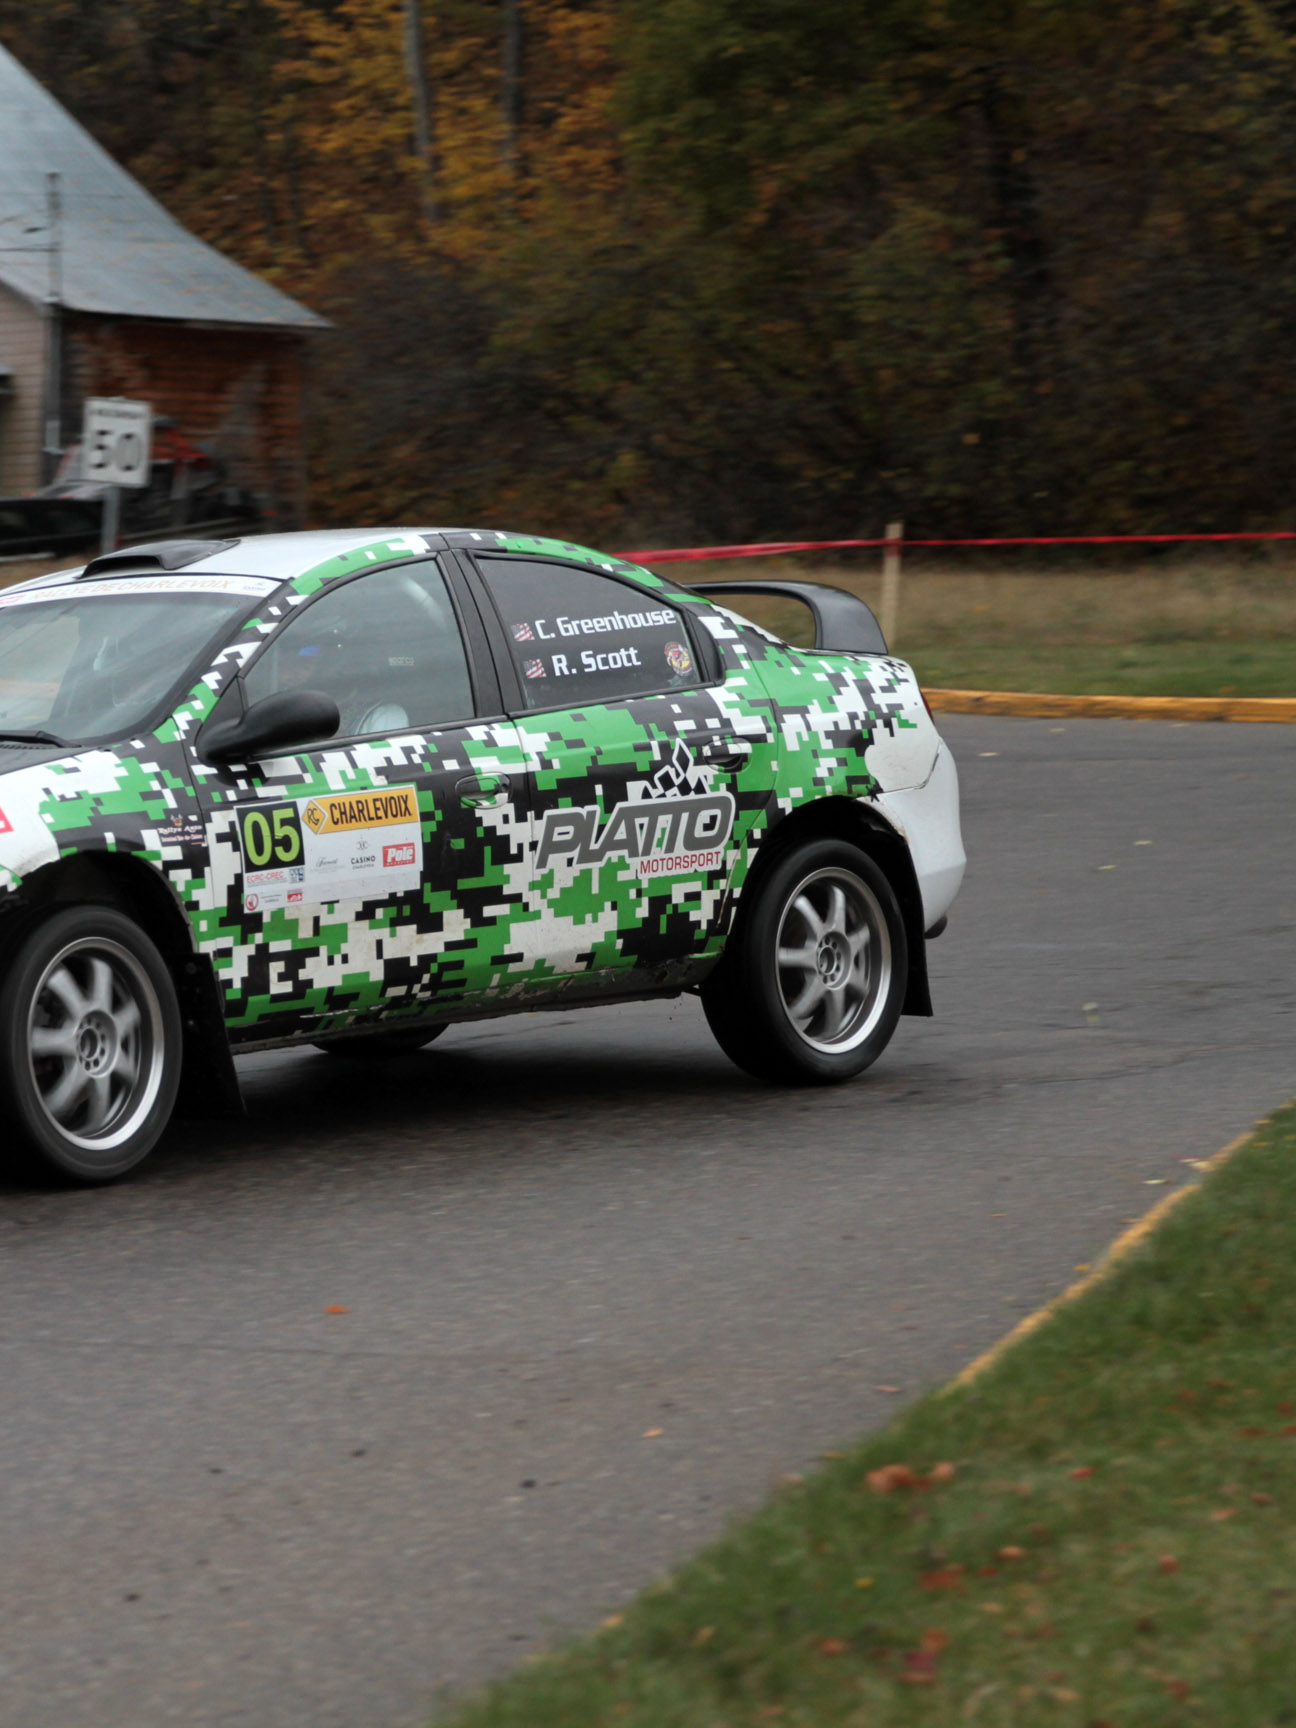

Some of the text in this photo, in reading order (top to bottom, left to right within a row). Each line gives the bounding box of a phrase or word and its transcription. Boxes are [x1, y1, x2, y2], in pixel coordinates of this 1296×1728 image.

[91, 430, 141, 472] 50
[117, 579, 233, 592] CHARLEVOIX
[535, 609, 677, 640] C. Greenhouse
[551, 654, 577, 677] R.
[580, 646, 642, 673] Scott
[329, 794, 412, 826] CHARLEVOIX
[243, 808, 301, 866] 05
[535, 795, 733, 870] PLATTO
[350, 855, 376, 865] CASINO
[387, 847, 414, 863] Pole
[640, 851, 722, 875] MOTORSPORT
